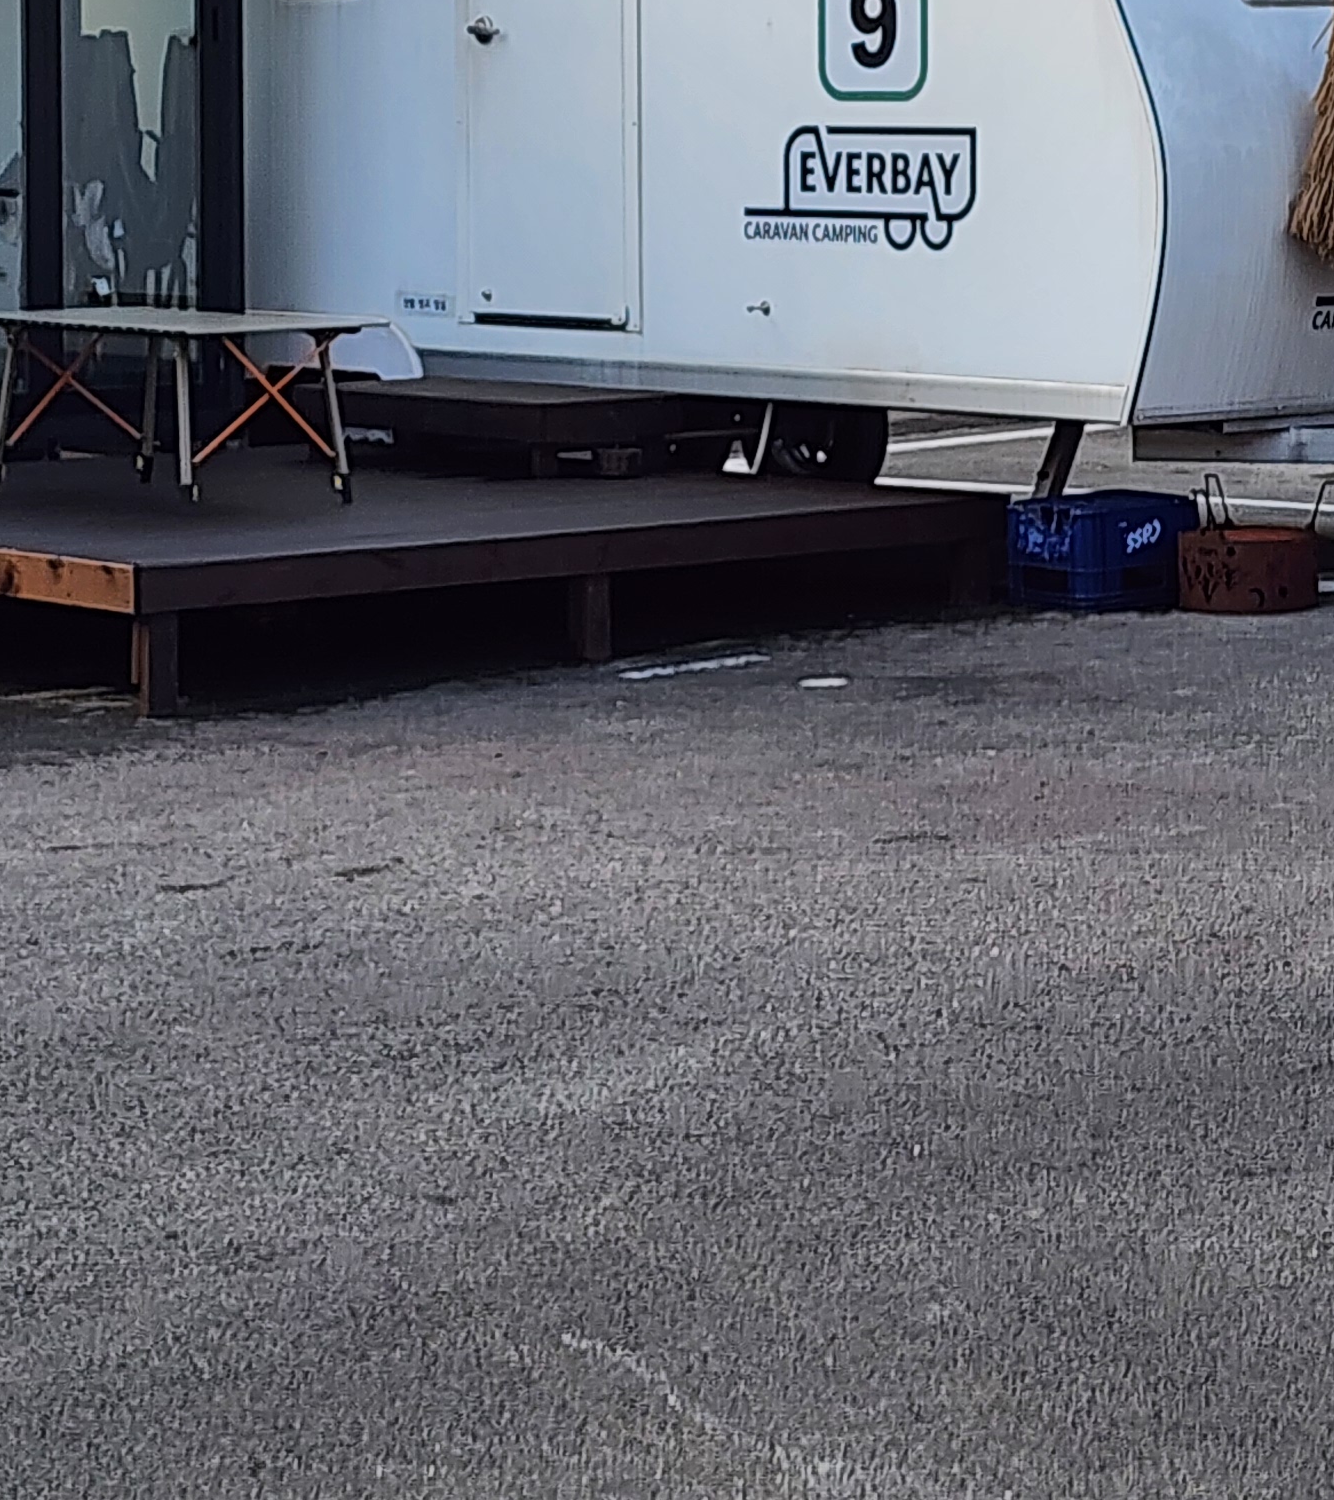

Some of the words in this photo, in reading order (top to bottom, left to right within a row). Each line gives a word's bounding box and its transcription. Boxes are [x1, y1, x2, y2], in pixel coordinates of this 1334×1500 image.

[799, 150, 961, 197] EVERBAY
[743, 221, 810, 242] CARAVAN
[812, 222, 879, 244] CAMPING
